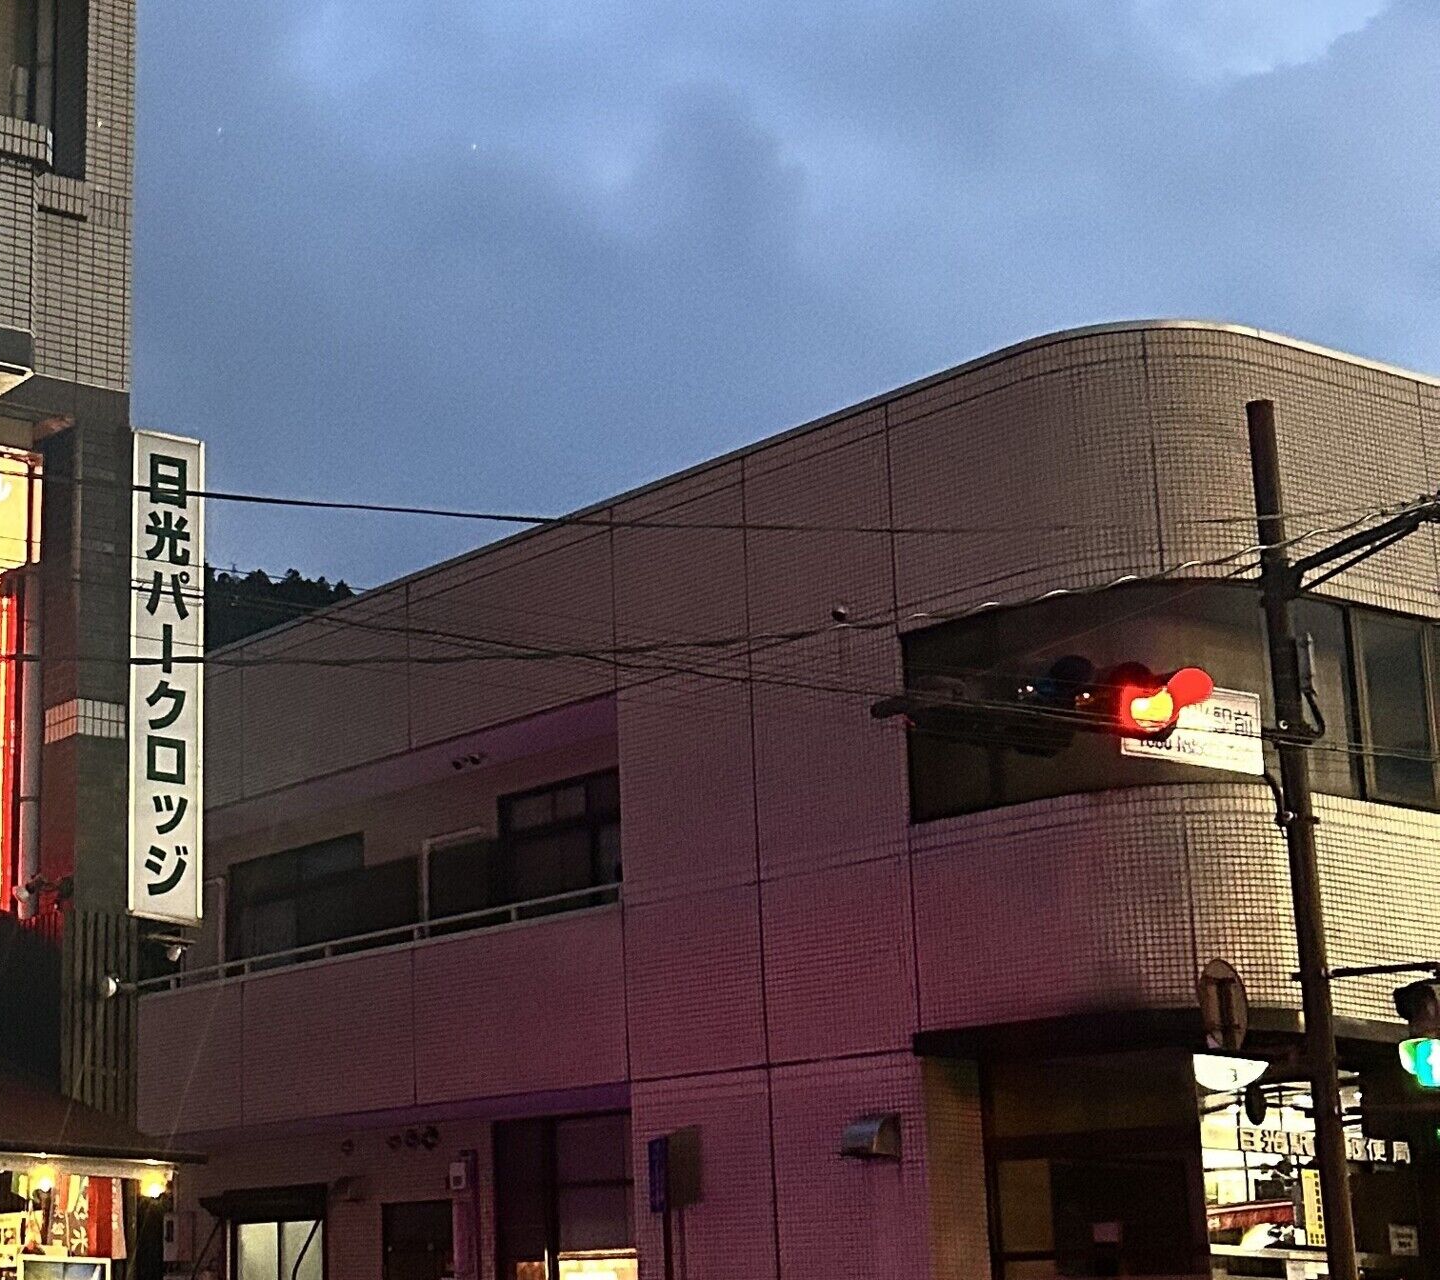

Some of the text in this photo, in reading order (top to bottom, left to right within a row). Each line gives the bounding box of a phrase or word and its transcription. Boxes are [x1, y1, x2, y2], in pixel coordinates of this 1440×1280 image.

[144, 453, 191, 897] 日光パークロッジ
